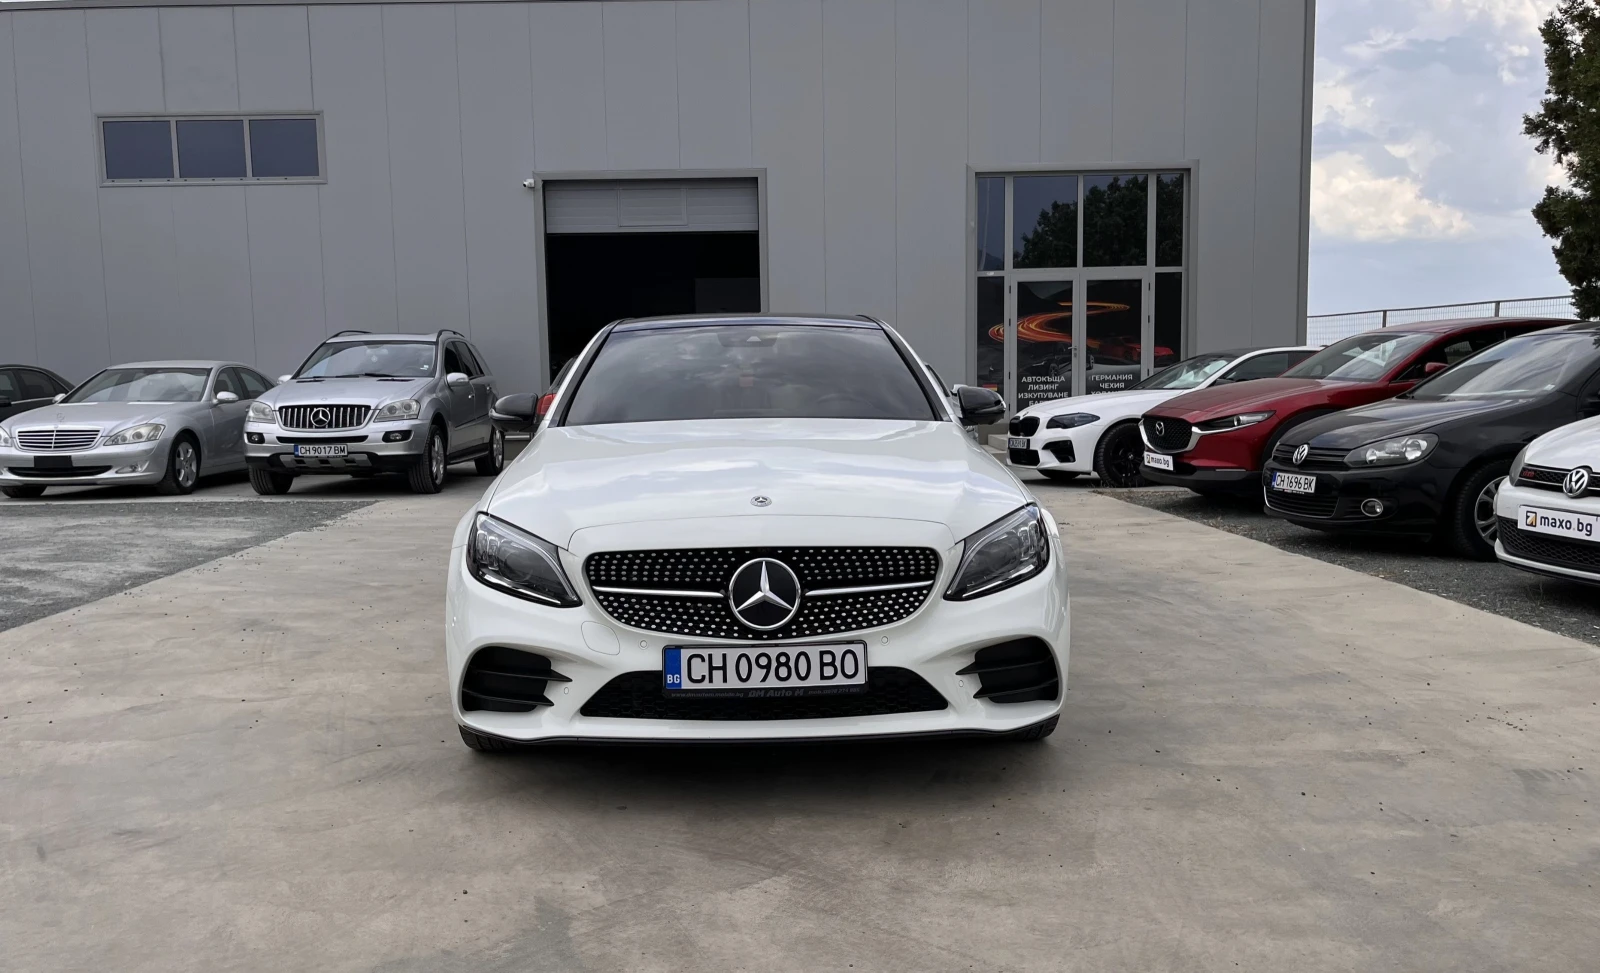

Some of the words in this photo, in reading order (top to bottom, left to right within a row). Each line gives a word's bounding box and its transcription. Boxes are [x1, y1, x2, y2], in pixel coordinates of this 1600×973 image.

[1021, 375, 1066, 383] АВТОКЪЩА
[1018, 391, 1069, 399] ИЗКУПУВАНЕ
[300, 446, 311, 455] CH
[311, 446, 333, 455] 9017
[333, 446, 346, 455] BM
[1275, 474, 1286, 487] CH
[1286, 475, 1303, 490] 1696
[1302, 477, 1315, 491] BK
[1539, 515, 1593, 537] maxo.bg
[686, 653, 728, 684] CH
[735, 650, 812, 683] 0980
[819, 648, 859, 681] BO
[666, 674, 681, 684] BG
[766, 689, 792, 698] Auto
